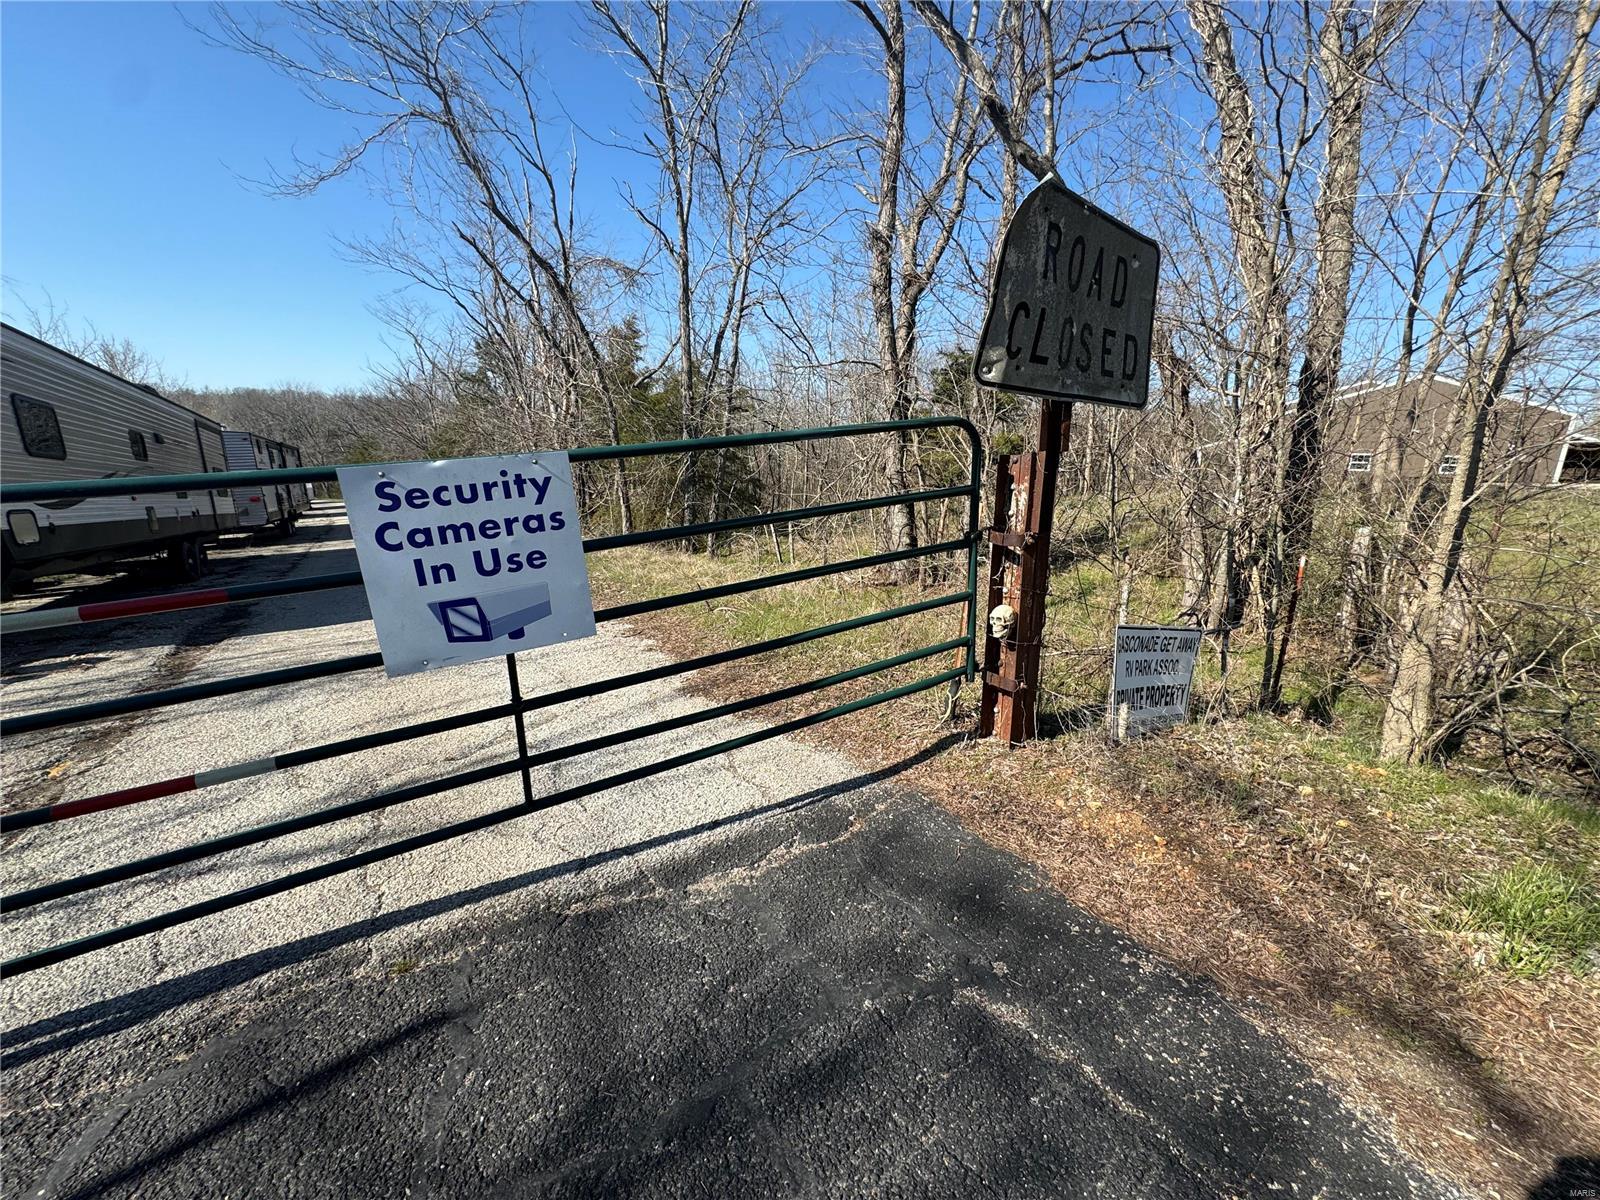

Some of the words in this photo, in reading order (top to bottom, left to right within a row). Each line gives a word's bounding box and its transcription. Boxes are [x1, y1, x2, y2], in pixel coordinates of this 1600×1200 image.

[1042, 221, 1128, 308] ROAD
[1006, 301, 1138, 381] CLOSED
[374, 470, 552, 512] Security
[374, 511, 566, 551] Cameras
[413, 558, 457, 586] In
[472, 548, 547, 577] Use
[1160, 636, 1178, 653] GET
[1177, 637, 1200, 653] AWAY
[1125, 659, 1134, 677] RV
[1134, 659, 1154, 677] PARK
[1145, 683, 1187, 709] PROPERTY
